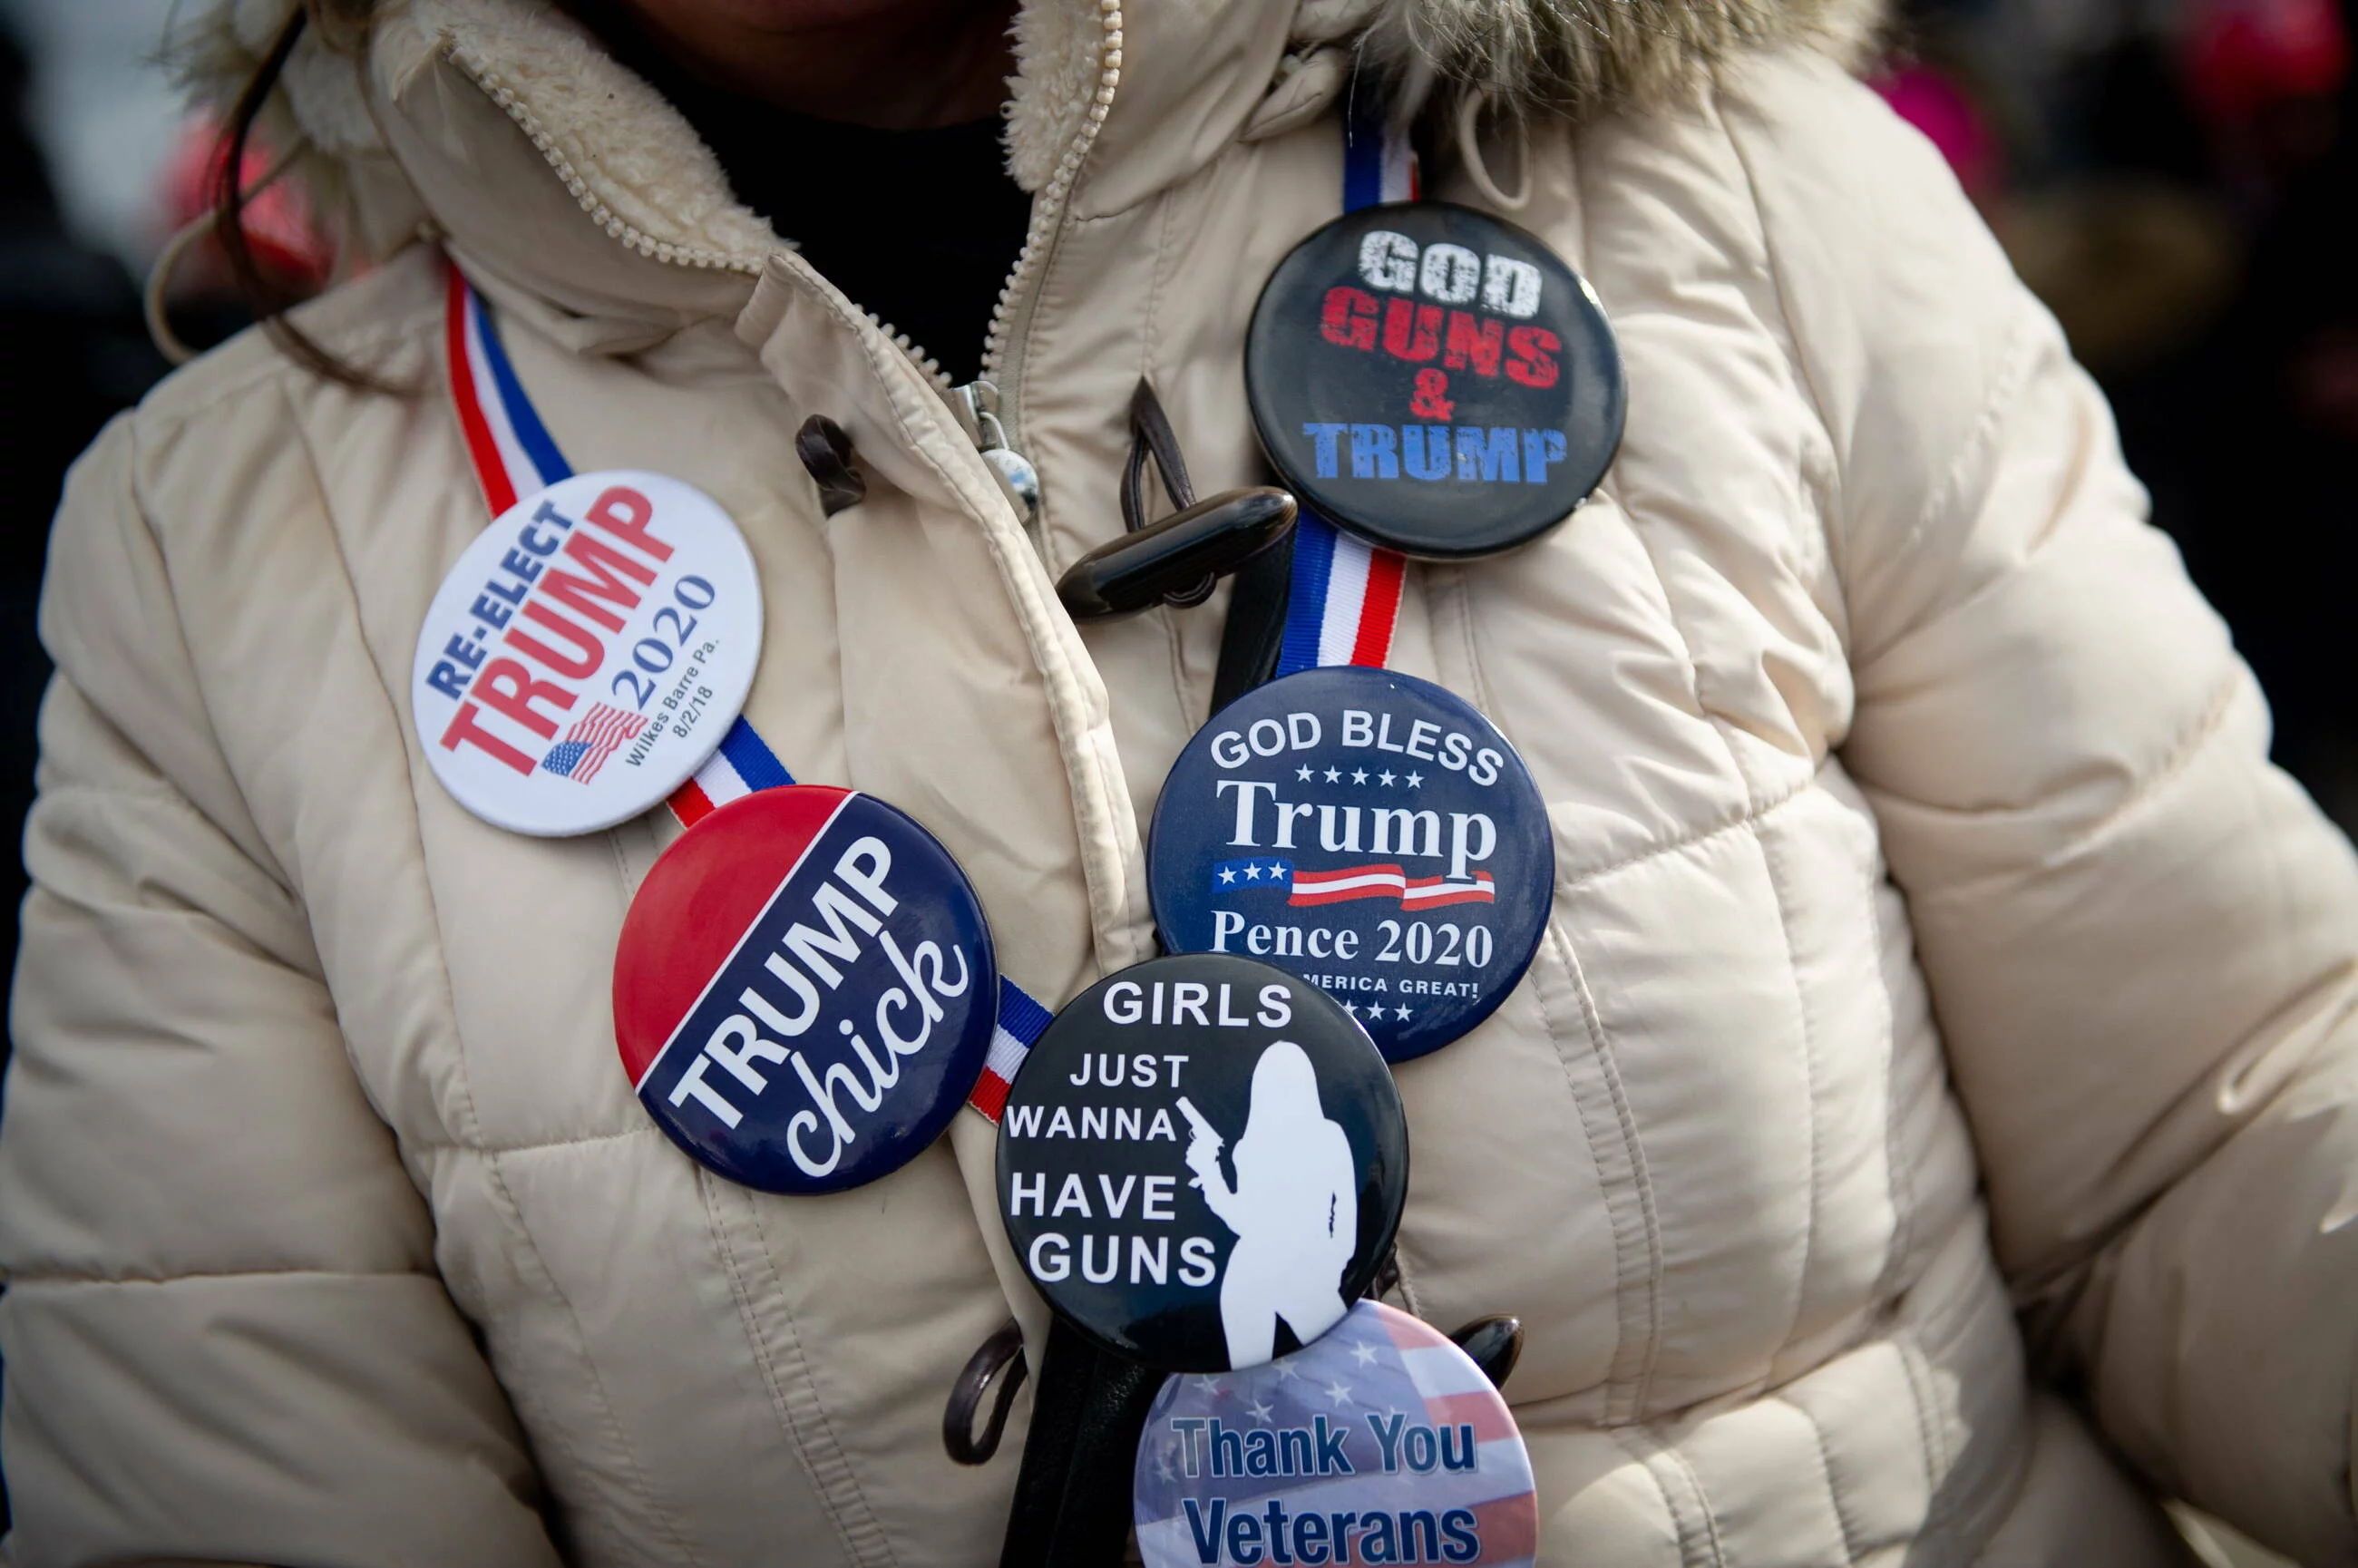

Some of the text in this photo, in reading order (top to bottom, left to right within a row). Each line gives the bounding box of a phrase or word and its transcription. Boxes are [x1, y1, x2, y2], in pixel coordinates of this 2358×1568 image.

[1358, 230, 1543, 319] GOD
[1320, 286, 1562, 389] GUNS
[1409, 367, 1455, 422] &
[1302, 423, 1567, 484] TRUMP
[425, 499, 573, 701] RE-ELECT
[440, 486, 675, 777] TRUMP
[611, 575, 716, 711] 2020
[626, 638, 719, 767] Wilkes Barre Pa.
[673, 686, 713, 738] 8/2/18
[1211, 709, 1504, 786] GOD BLESS
[1216, 779, 1496, 881] Trump
[1210, 910, 1493, 969] Pence 2020
[667, 836, 899, 1130] TRUMP
[1104, 981, 1292, 1028] GIRLS
[1303, 974, 1478, 998] MERICA GREAT!
[787, 930, 969, 1177] chick
[1069, 1053, 1189, 1087] JUST
[1007, 1105, 1177, 1142] WANNA
[1009, 1172, 1176, 1221] HAVE
[1028, 1232, 1216, 1287] GUNS
[1171, 1412, 1477, 1478] Thank You
[1182, 1498, 1480, 1566] Veterans
